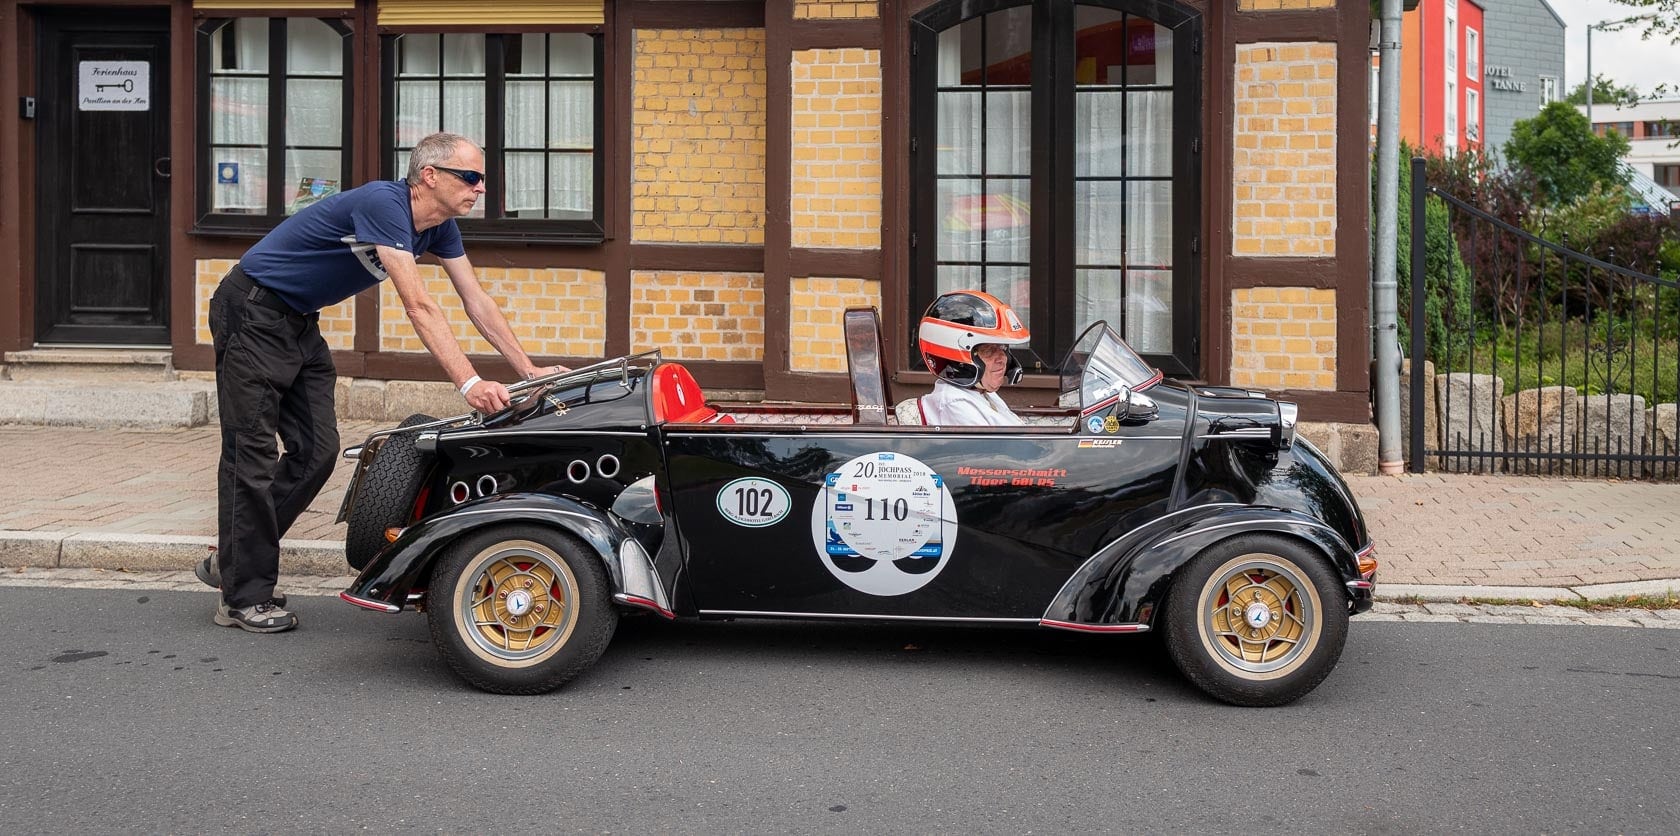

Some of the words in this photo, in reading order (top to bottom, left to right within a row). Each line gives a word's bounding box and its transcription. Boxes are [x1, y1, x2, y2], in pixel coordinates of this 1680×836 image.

[91, 67, 137, 76] Ferienhaus
[1494, 79, 1527, 91] TANNE
[853, 461, 878, 478] 20.
[957, 466, 1067, 477] Messerschmitt
[970, 476, 1008, 486] Tiger
[735, 487, 773, 517] 102
[864, 497, 909, 521] 110
